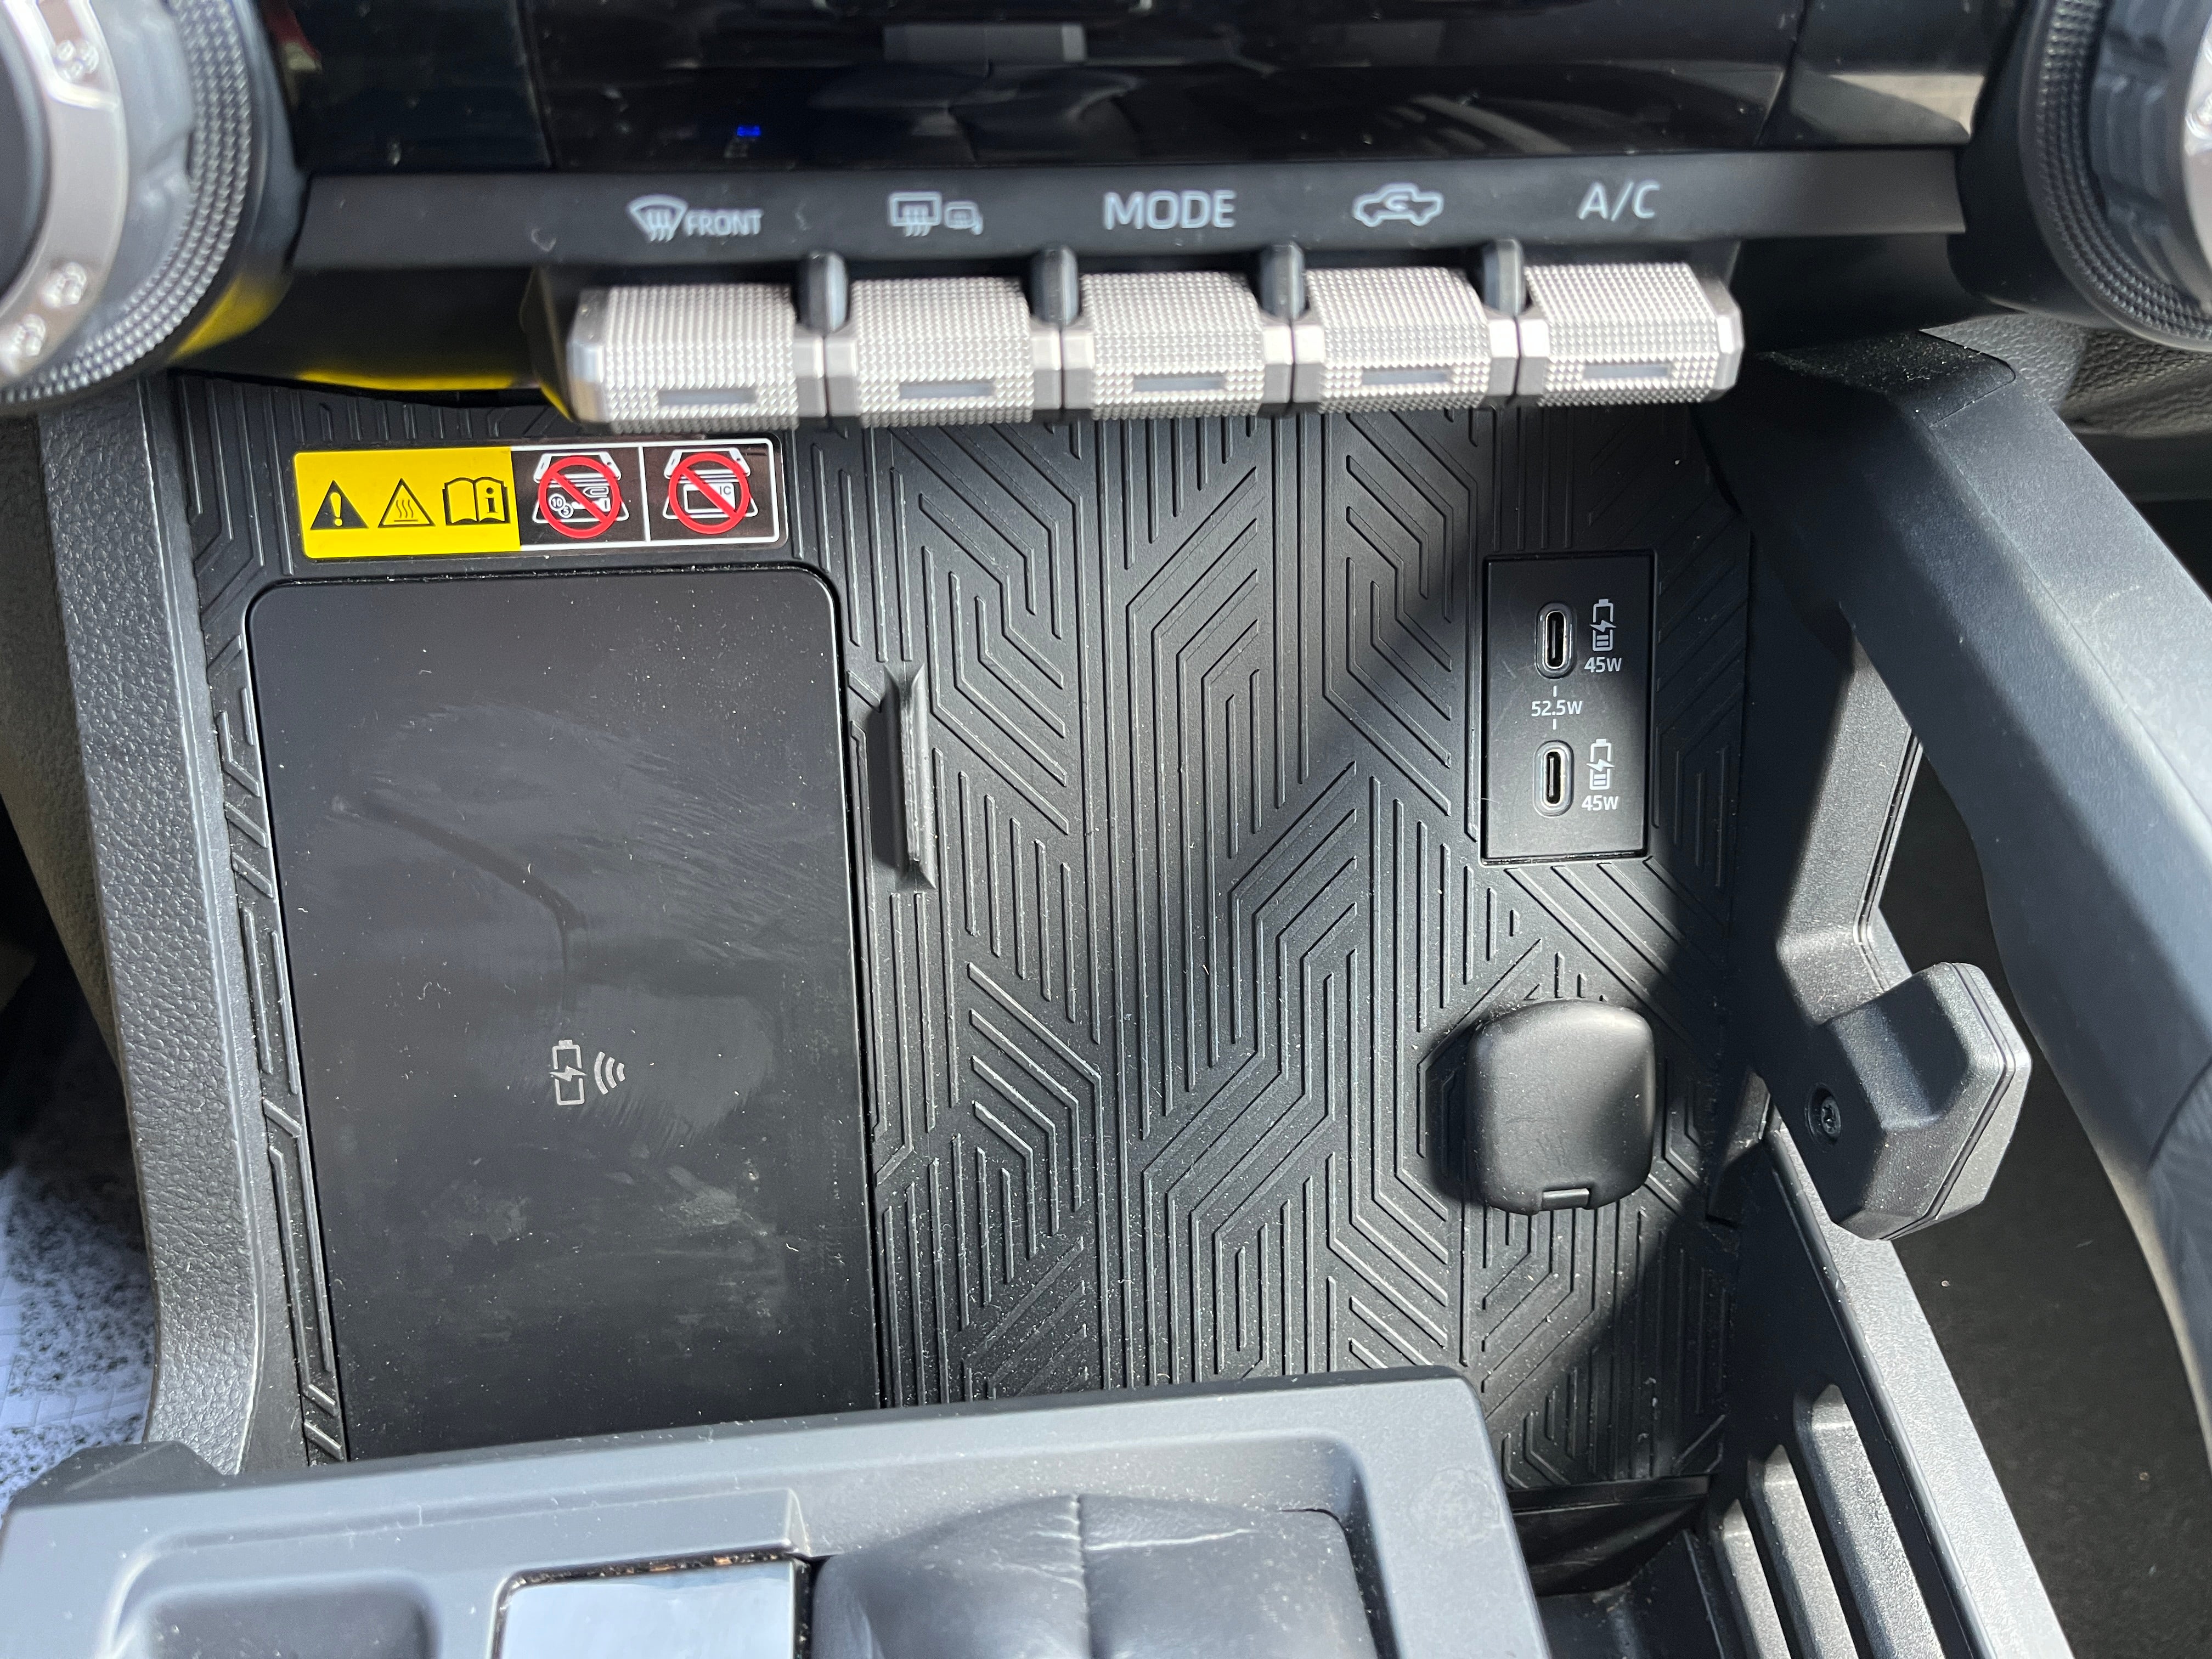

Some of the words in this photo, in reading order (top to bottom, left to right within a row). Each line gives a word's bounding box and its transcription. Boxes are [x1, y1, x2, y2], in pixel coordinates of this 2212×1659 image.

[1577, 180, 1659, 221] A/C
[1104, 190, 1236, 230] MODE
[684, 208, 763, 236] FRONT
[719, 486, 731, 495] IC
[552, 498, 563, 507] 10
[1584, 657, 1622, 673] 45W
[1531, 700, 1582, 716] 52.5W
[1581, 795, 1618, 811] 45W
